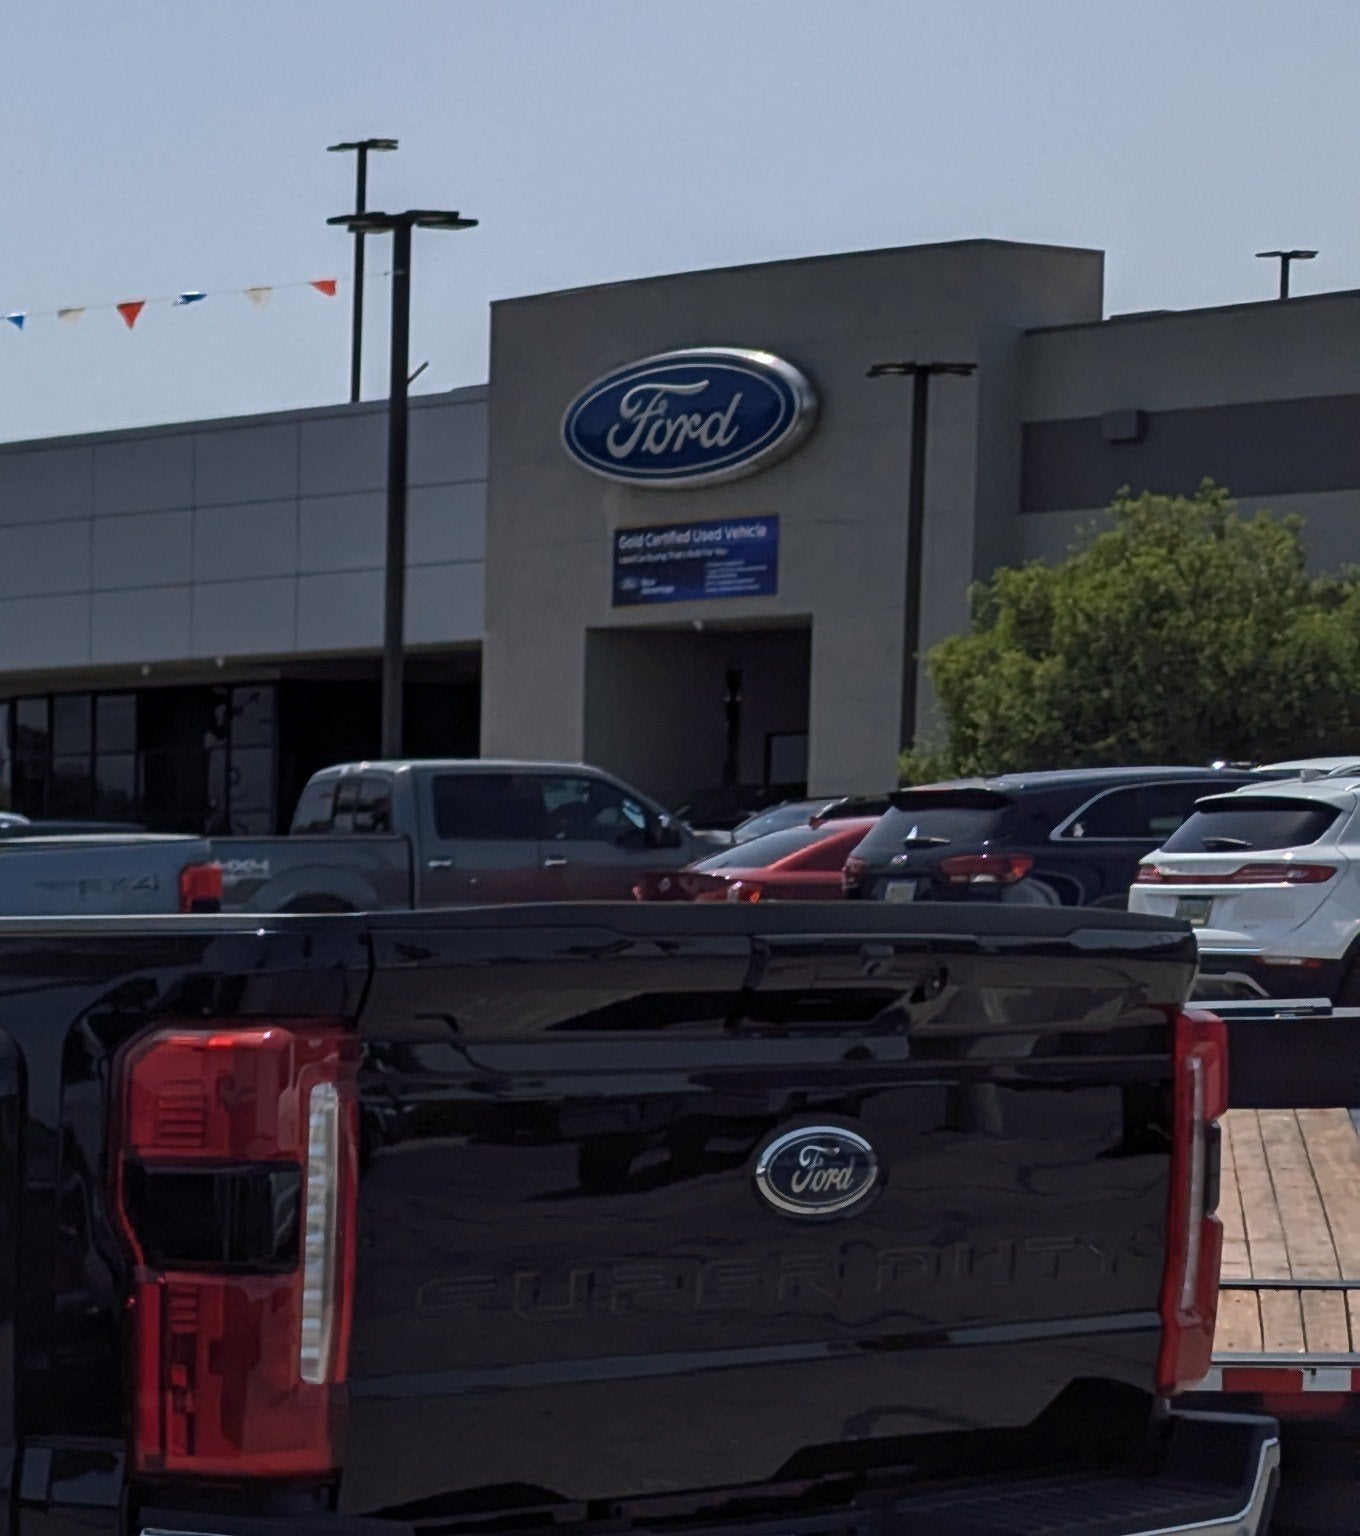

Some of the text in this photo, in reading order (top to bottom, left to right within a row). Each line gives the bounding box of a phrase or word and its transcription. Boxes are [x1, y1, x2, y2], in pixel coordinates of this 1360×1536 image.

[606, 379, 744, 459] Ford
[693, 527, 722, 542] Used
[791, 1145, 856, 1193] Ford
